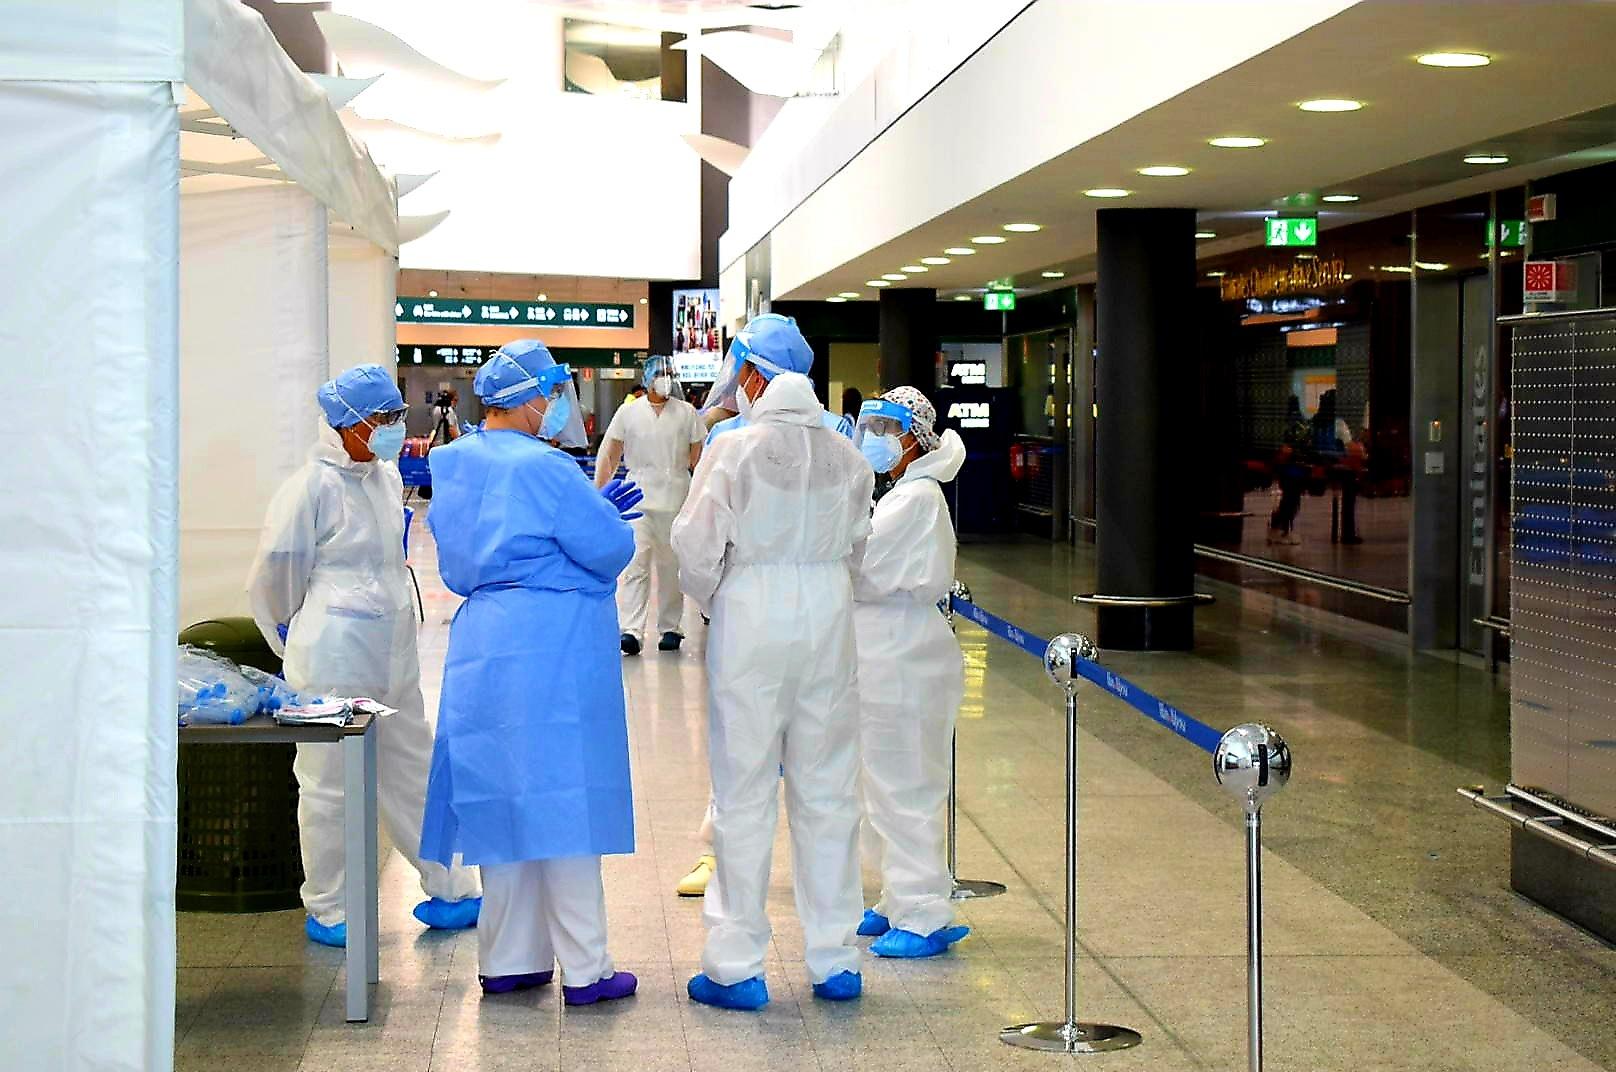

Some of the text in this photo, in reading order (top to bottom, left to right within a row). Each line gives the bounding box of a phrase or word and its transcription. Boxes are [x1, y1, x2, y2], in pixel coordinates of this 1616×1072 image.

[951, 363, 986, 377] ATM
[947, 402, 990, 418] ATM
[1470, 345, 1487, 585] Emirates
